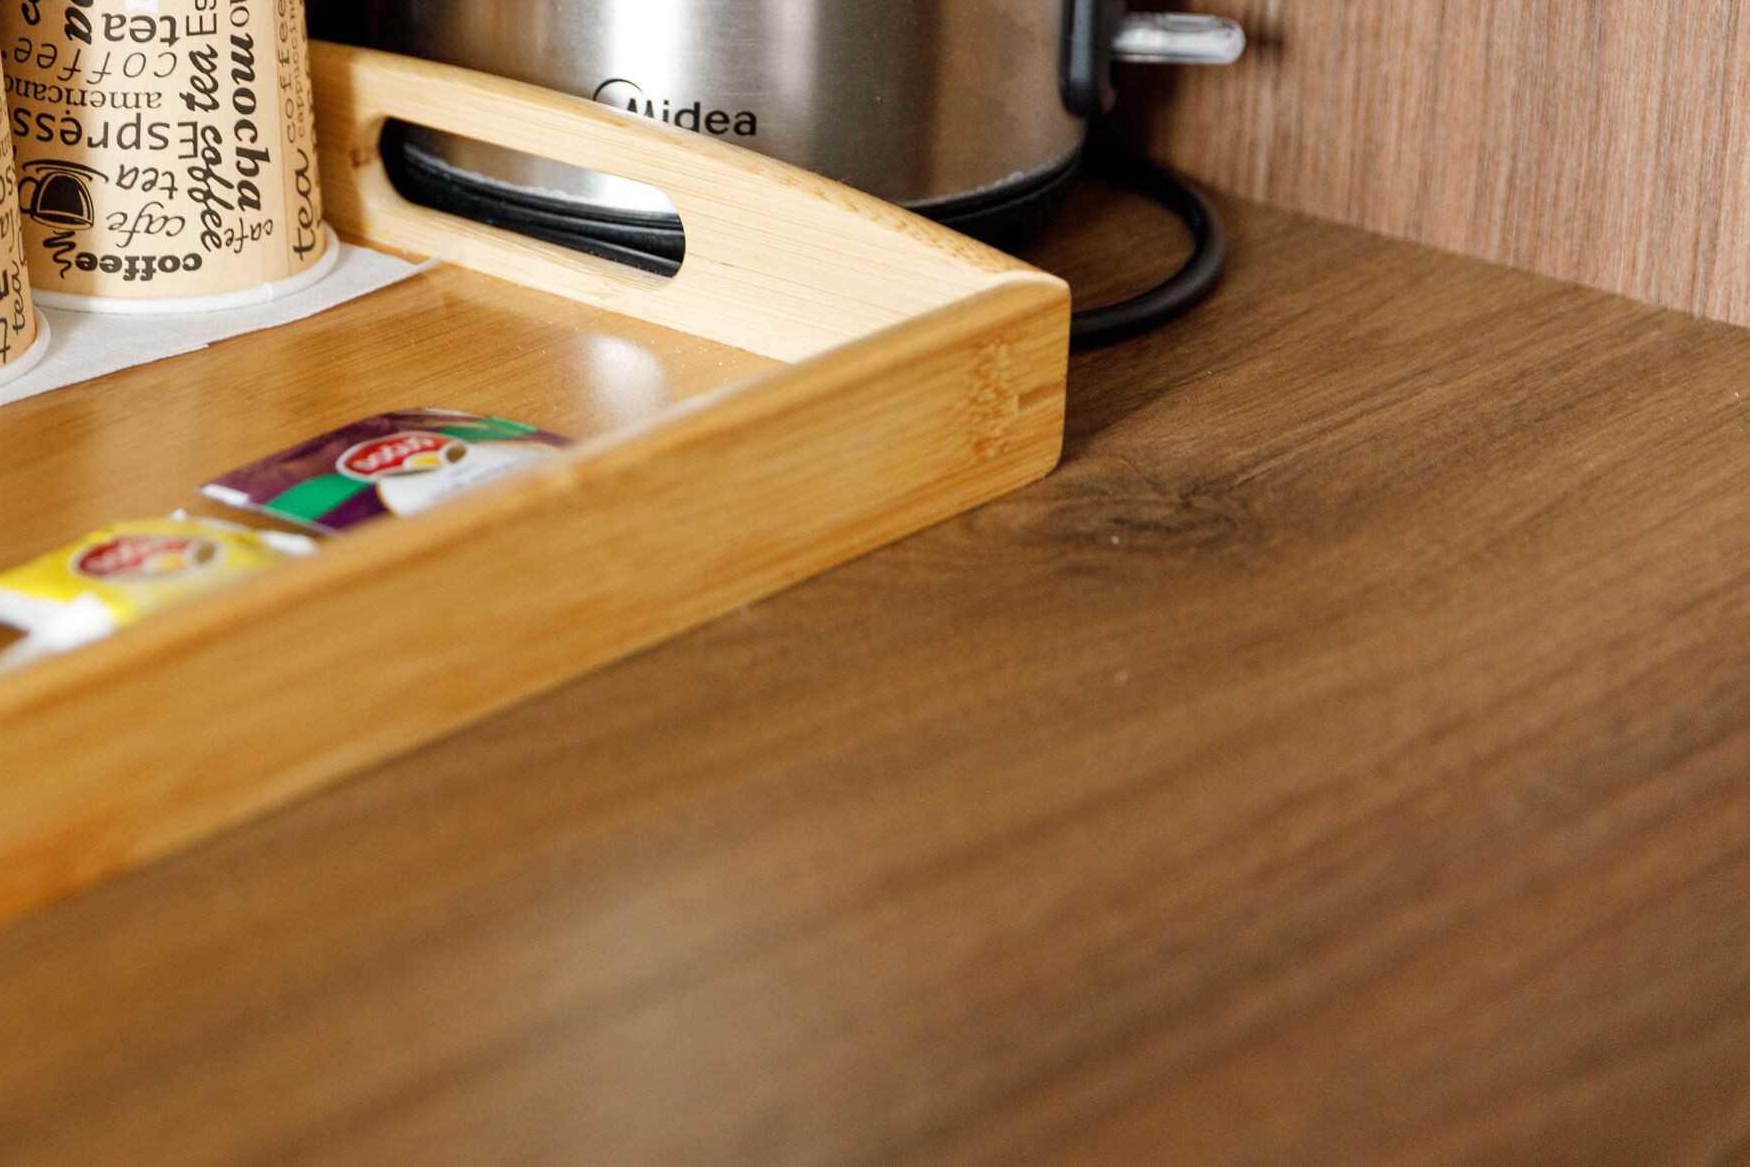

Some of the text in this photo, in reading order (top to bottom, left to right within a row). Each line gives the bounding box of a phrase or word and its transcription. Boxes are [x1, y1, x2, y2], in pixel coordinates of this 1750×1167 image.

[103, 13, 180, 47] tea
[14, 38, 178, 86] coffee
[182, 43, 219, 113] tea
[13, 107, 199, 160] Espress
[227, 33, 271, 212] mocha
[116, 162, 179, 200] tea
[187, 126, 224, 252] coffee
[293, 147, 316, 262] tea
[106, 208, 186, 249] cafe
[223, 218, 274, 255] cafe
[75, 249, 204, 282] coffee
[10, 260, 27, 335] tea
